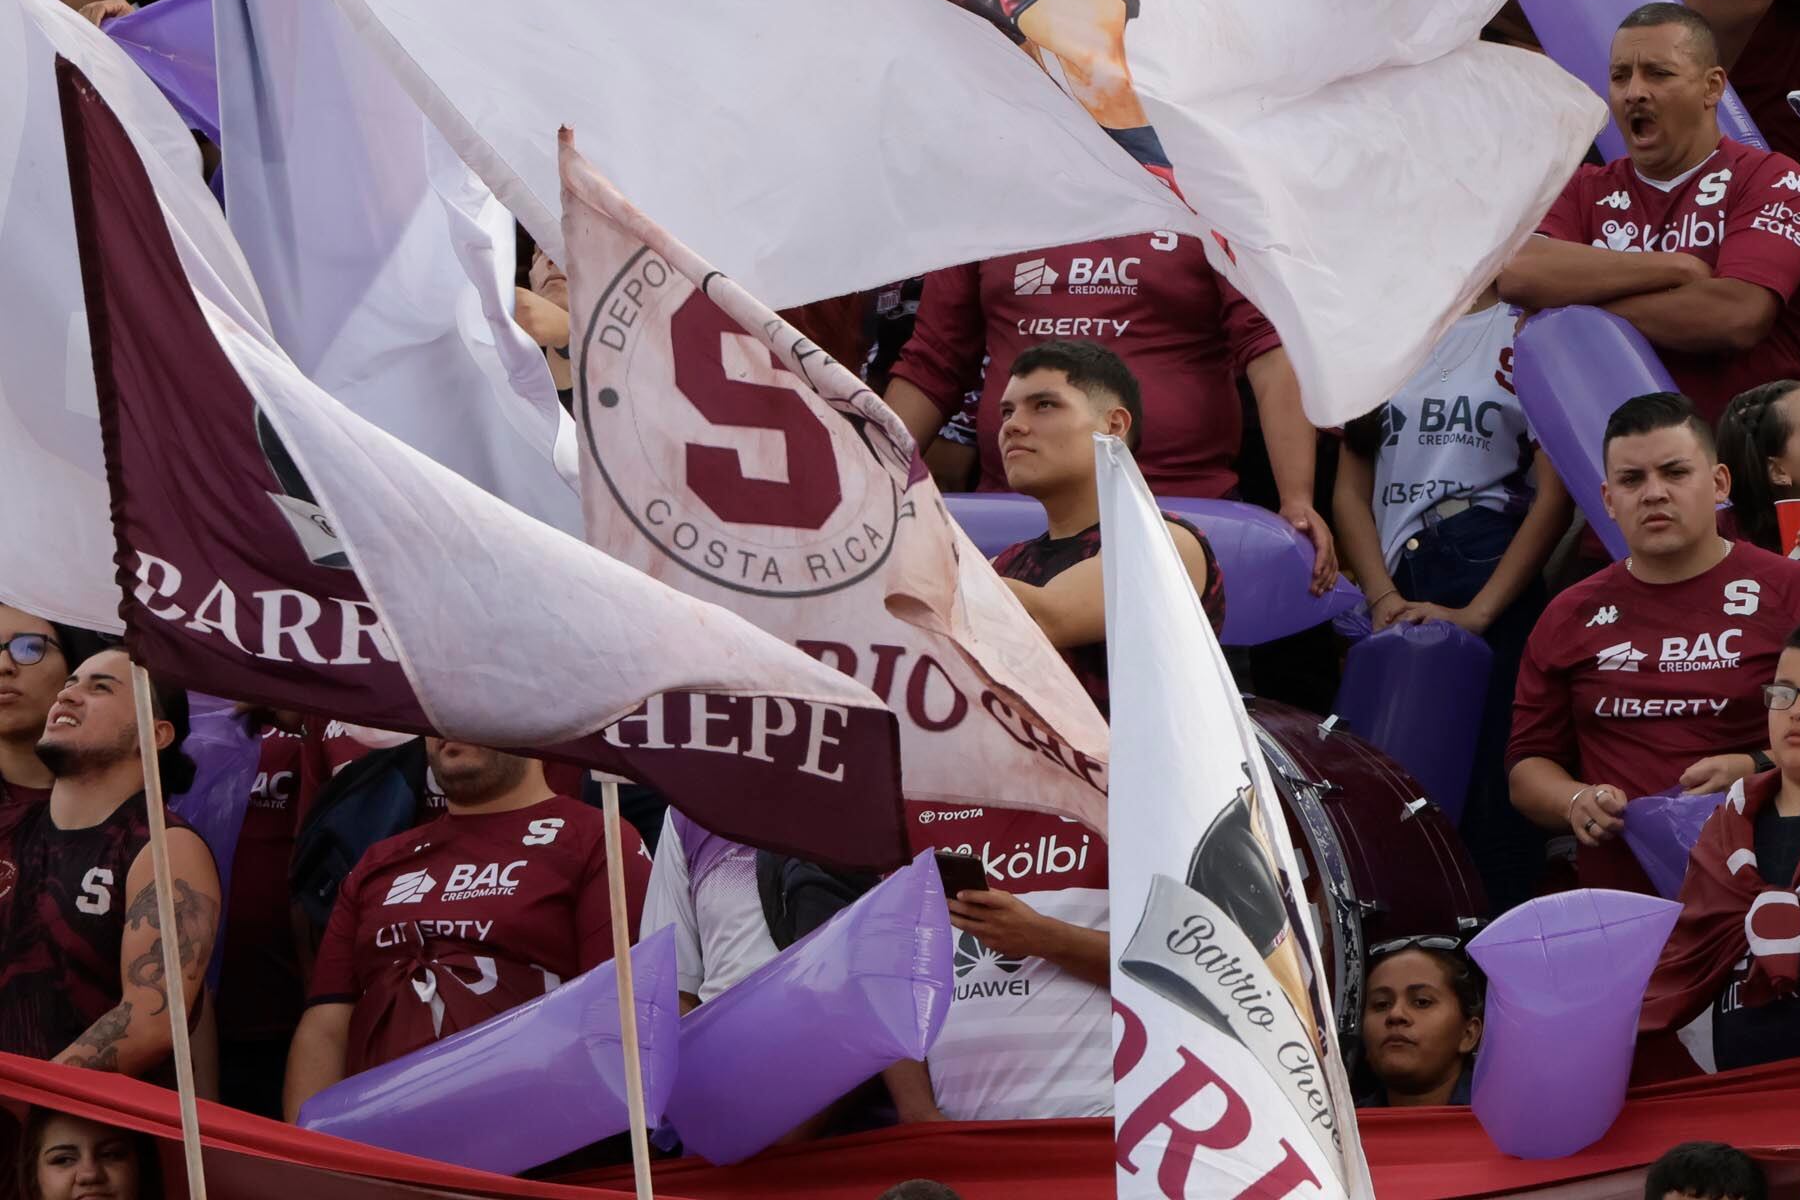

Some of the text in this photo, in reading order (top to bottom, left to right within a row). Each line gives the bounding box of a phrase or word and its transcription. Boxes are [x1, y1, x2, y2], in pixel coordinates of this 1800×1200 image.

[1696, 169, 1732, 206] S
[1643, 211, 1725, 254] kölbi
[1069, 257, 1140, 286] BAC
[600, 257, 676, 352] DEPO
[1068, 283, 1139, 296] CREDOMATIC
[1018, 316, 1130, 339] LIBERTY
[1419, 395, 1501, 440] BAC
[1418, 433, 1495, 454] CREDOMATIC
[647, 499, 884, 583] COSTA RICA
[1724, 580, 1760, 615] S
[1658, 628, 1742, 662] BAC
[1658, 659, 1740, 673] CREDOMATIC
[1594, 697, 1728, 719] LIBERTY
[252, 771, 293, 800] AC
[937, 807, 984, 821] TOYOTA
[523, 817, 567, 846] S
[983, 834, 1090, 881] kölbi
[77, 866, 114, 916] S
[444, 859, 529, 893] BAC
[441, 885, 520, 902] CREDOMATIC
[1166, 914, 1276, 1034] Barrio
